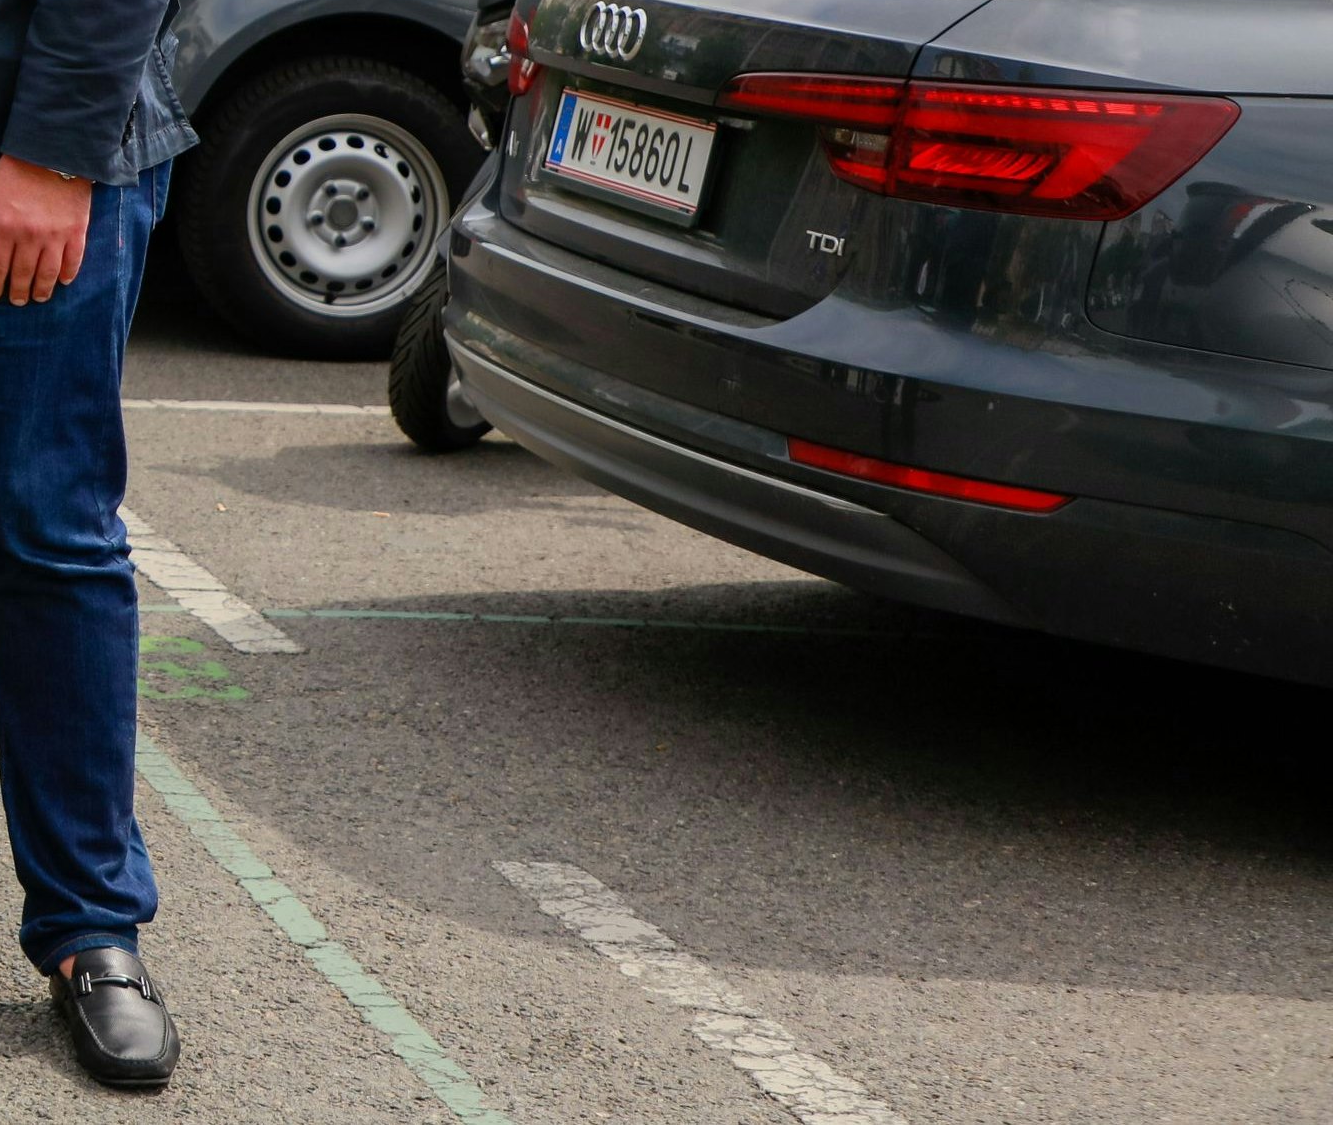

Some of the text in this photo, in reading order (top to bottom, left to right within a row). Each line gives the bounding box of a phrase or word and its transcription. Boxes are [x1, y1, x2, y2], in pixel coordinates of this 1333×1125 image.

[554, 138, 563, 155] A
[571, 107, 694, 193] W 15860L
[806, 229, 846, 257] TDI
